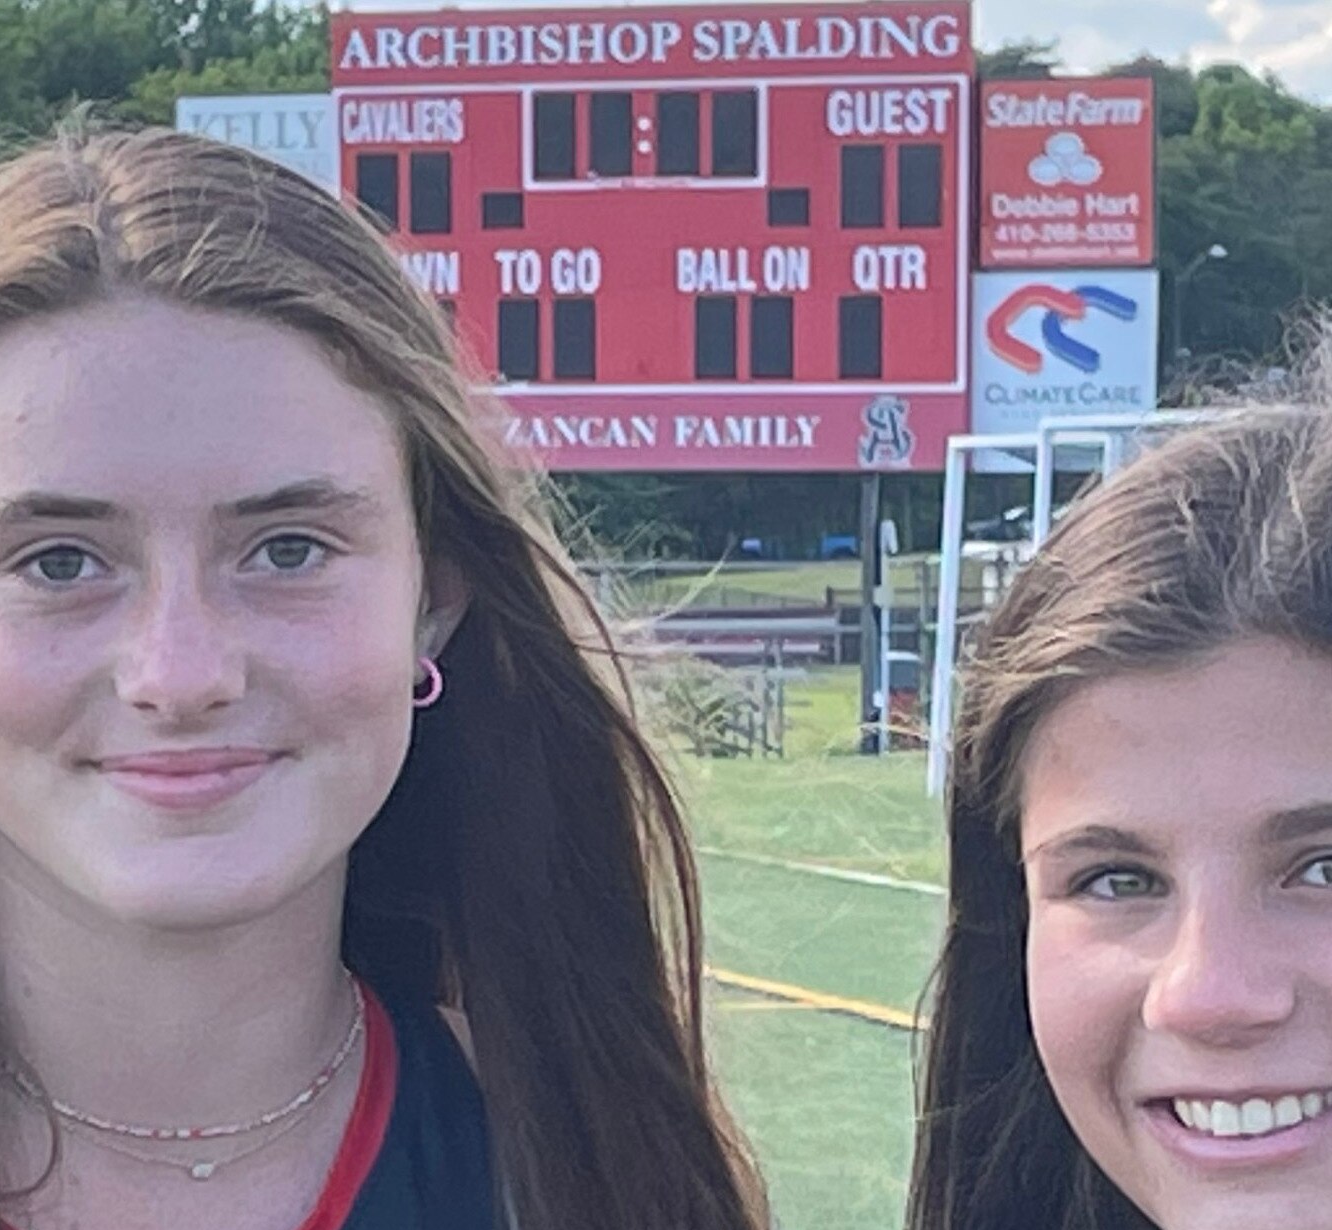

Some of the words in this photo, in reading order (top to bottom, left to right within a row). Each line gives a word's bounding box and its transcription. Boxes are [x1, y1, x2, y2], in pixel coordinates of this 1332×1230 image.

[339, 22, 682, 69] ARCHBISHOP
[693, 15, 960, 62] SPALDING
[186, 110, 326, 150] KELLY
[342, 98, 464, 144] CAVALIERS
[827, 87, 952, 137] GUEST
[399, 250, 460, 294] WN
[494, 249, 541, 294] TO
[550, 248, 601, 294] GO
[676, 248, 756, 293] BALL
[763, 246, 810, 293] ON
[504, 416, 659, 448] ZANCAN
[674, 415, 822, 448] FAMILY
